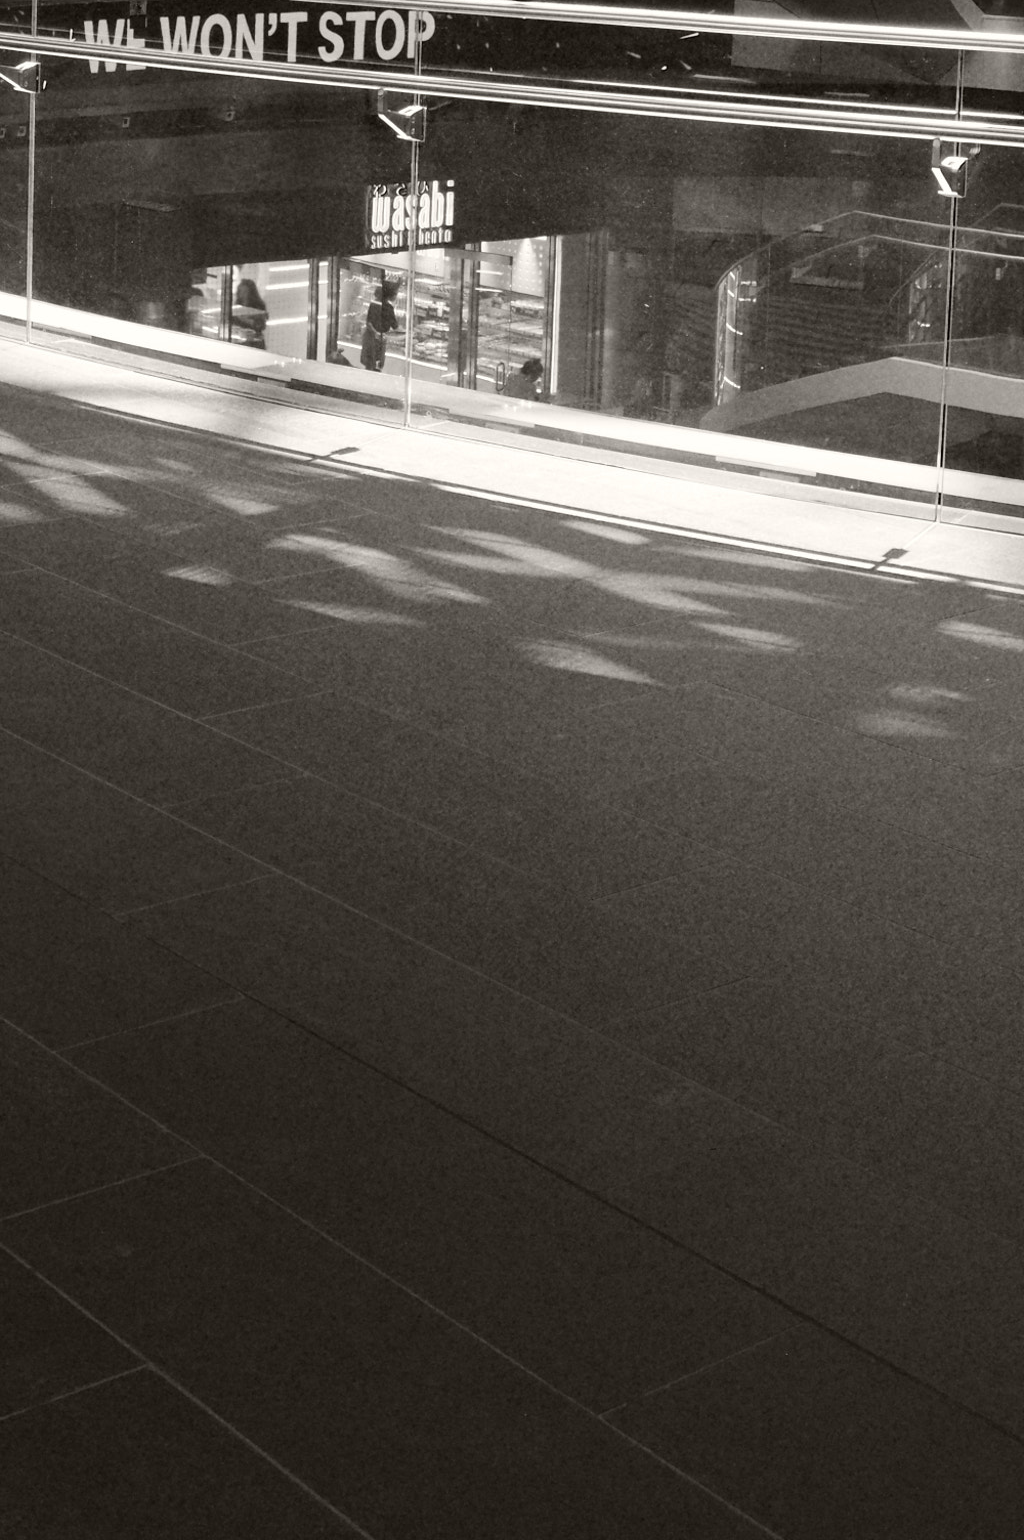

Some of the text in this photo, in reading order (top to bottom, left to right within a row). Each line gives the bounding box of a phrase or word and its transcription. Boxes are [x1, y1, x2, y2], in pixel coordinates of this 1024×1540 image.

[160, 11, 308, 63] WON'T
[318, 10, 436, 63] STOP
[371, 179, 455, 234] wasabi
[370, 230, 404, 250] sushi
[418, 227, 453, 246] bento
